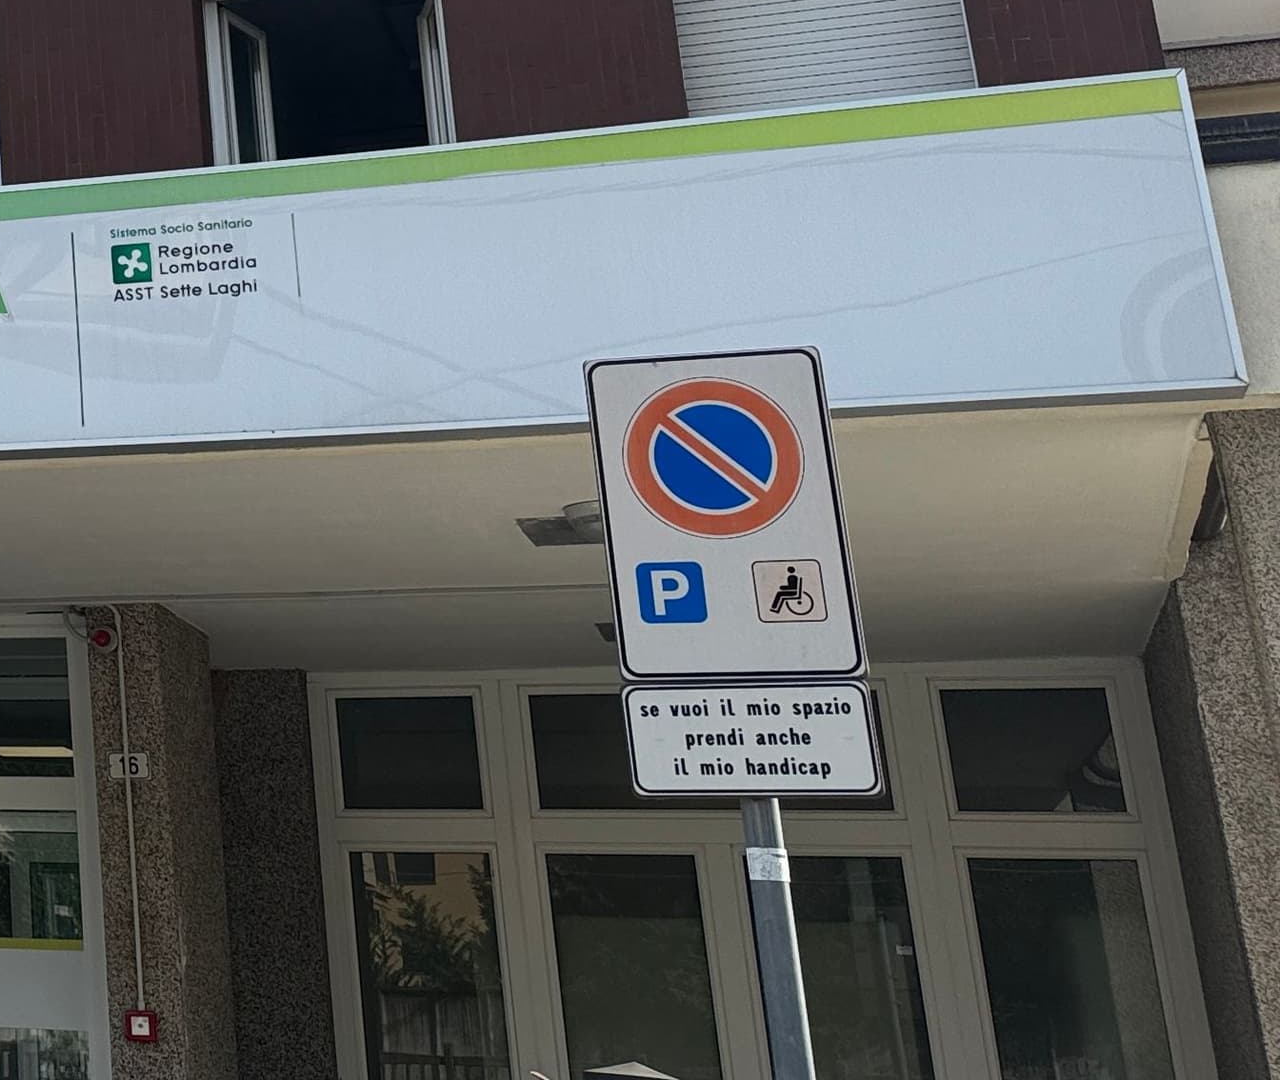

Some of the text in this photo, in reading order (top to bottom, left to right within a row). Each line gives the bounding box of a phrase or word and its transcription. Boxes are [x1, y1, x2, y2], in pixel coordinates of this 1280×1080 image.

[110, 218, 253, 239] Sistema Socio Sanitario
[158, 242, 234, 260] Regione
[159, 256, 257, 276] Lombardia
[114, 279, 258, 302] ASST Sette Laghi
[650, 570, 690, 616] P
[640, 697, 852, 720] se vuoi il mio spazio
[685, 728, 812, 749] prendi anche
[119, 756, 139, 776] 16
[674, 757, 832, 780] il mio handicap
